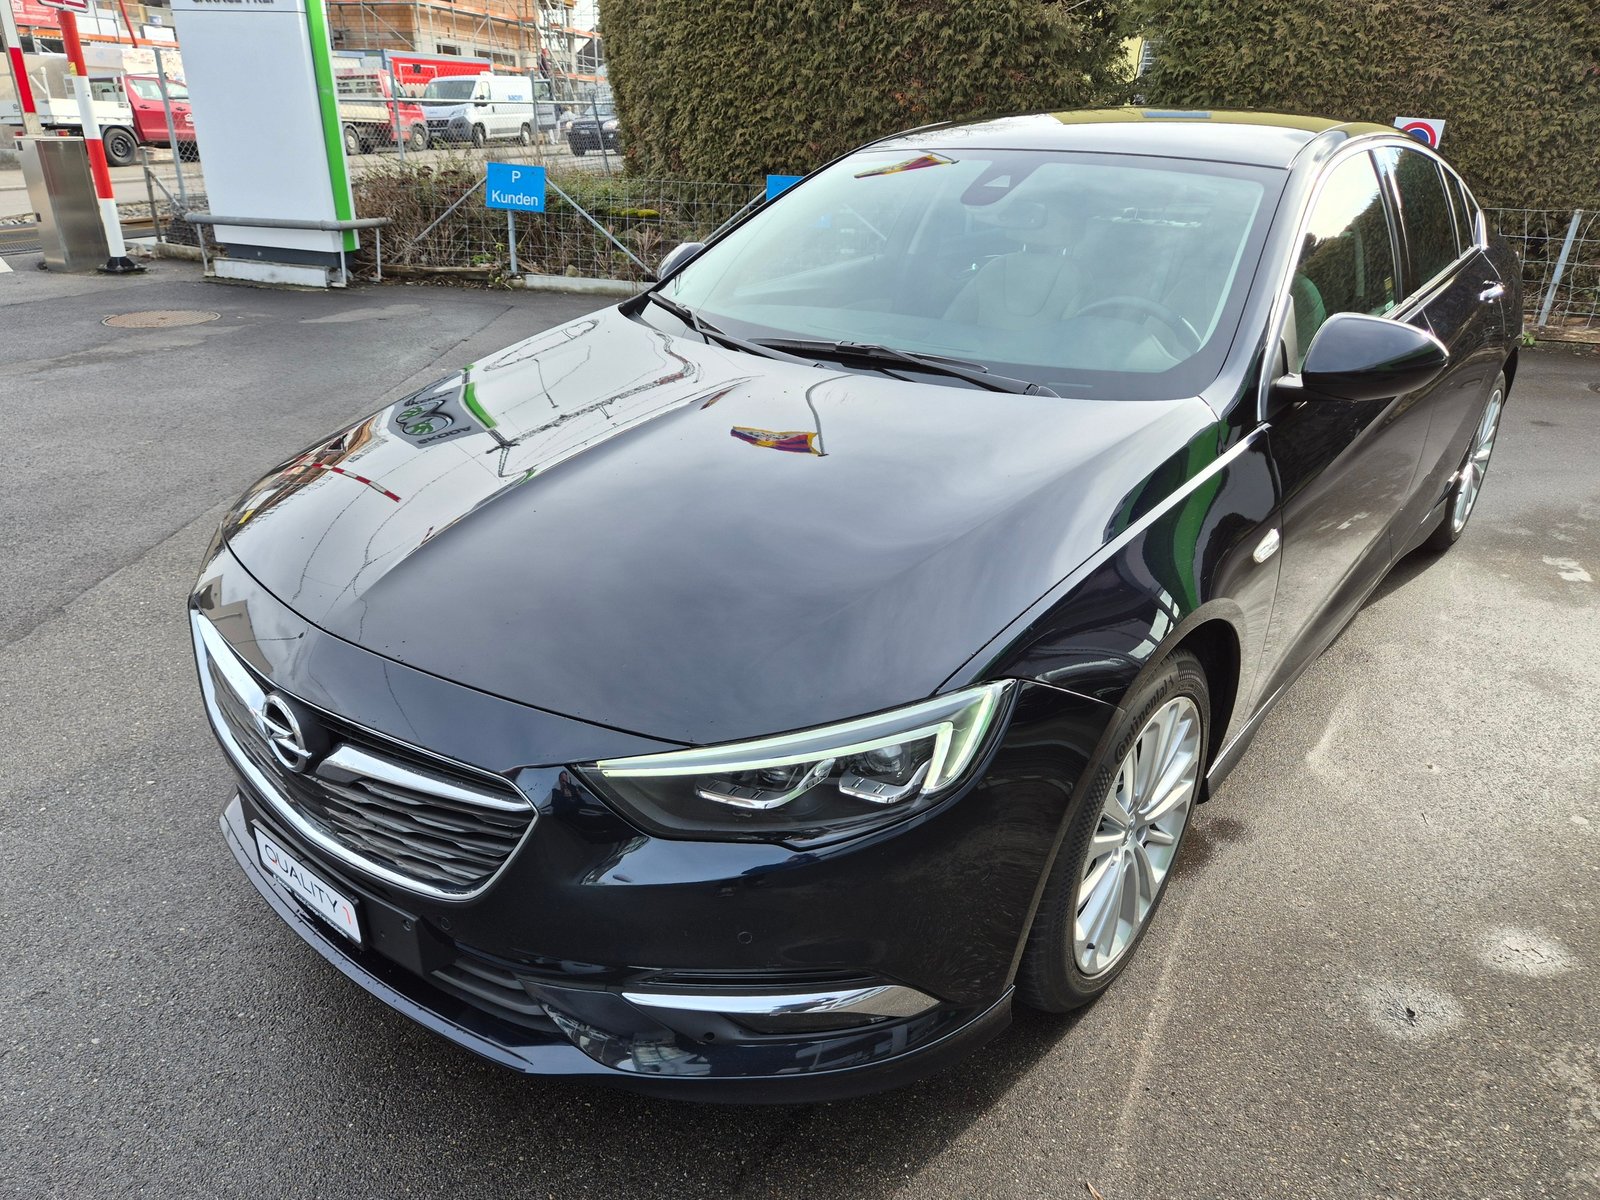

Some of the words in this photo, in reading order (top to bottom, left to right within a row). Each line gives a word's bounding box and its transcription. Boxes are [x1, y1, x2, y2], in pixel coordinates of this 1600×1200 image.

[491, 189, 538, 206] Kunden
[511, 170, 521, 183] P
[1115, 680, 1169, 765] Continental
[264, 844, 338, 912] QUALITY
[342, 905, 352, 925] 1
